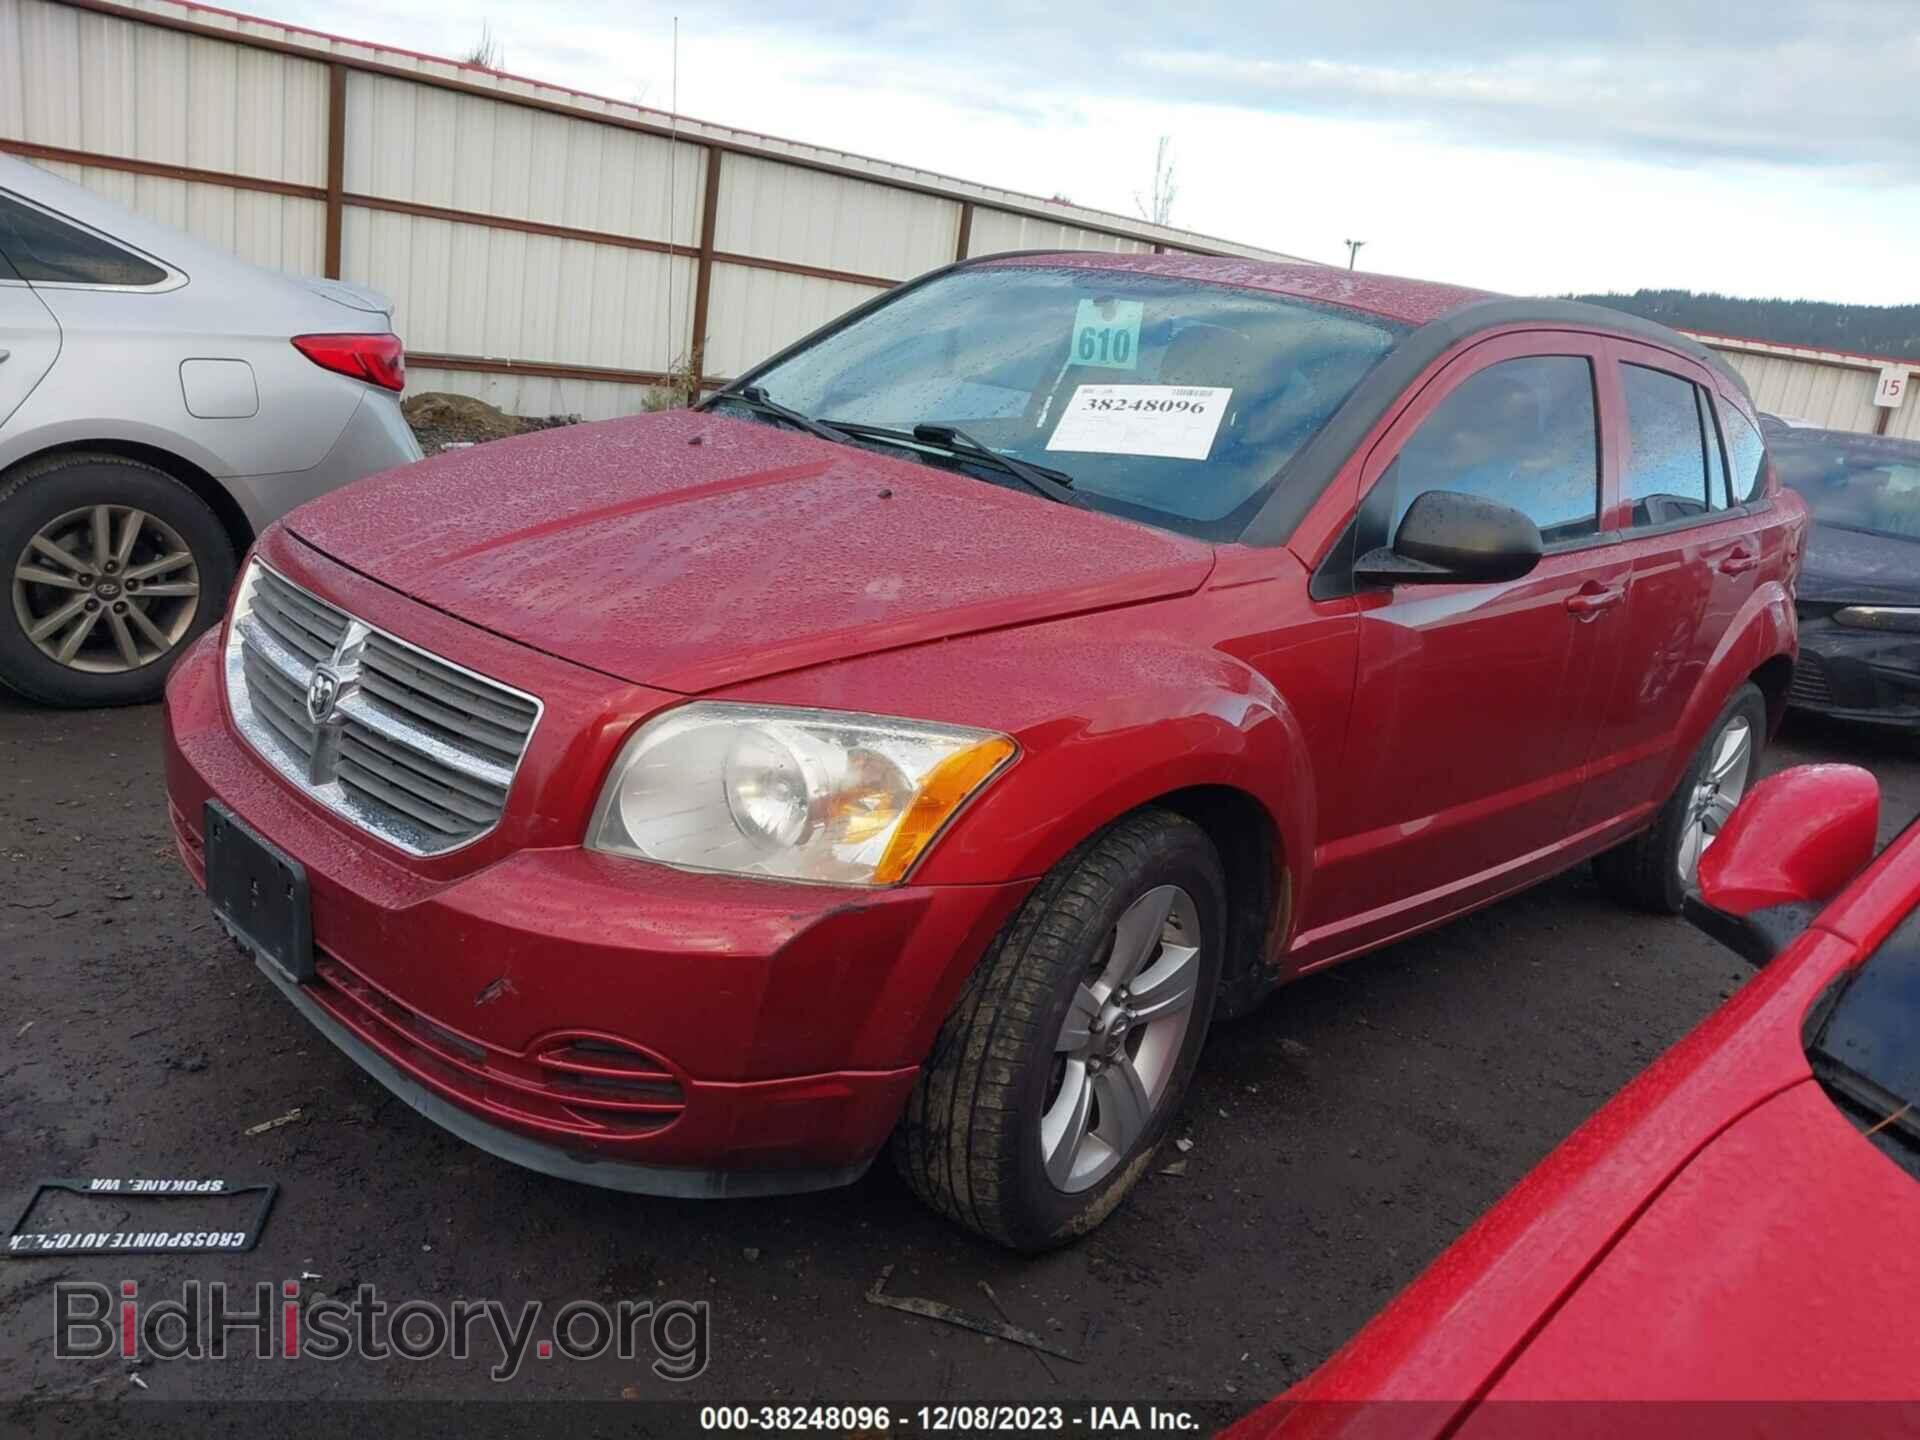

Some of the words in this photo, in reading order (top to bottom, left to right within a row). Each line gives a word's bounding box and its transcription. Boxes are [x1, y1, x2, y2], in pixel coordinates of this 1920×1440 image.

[1078, 327, 1130, 363] 610
[1882, 379, 1901, 396] 15
[1082, 398, 1206, 414] 38248096
[91, 1178, 121, 1191] WA
[110, 1232, 246, 1248] CROSSPOINTE
